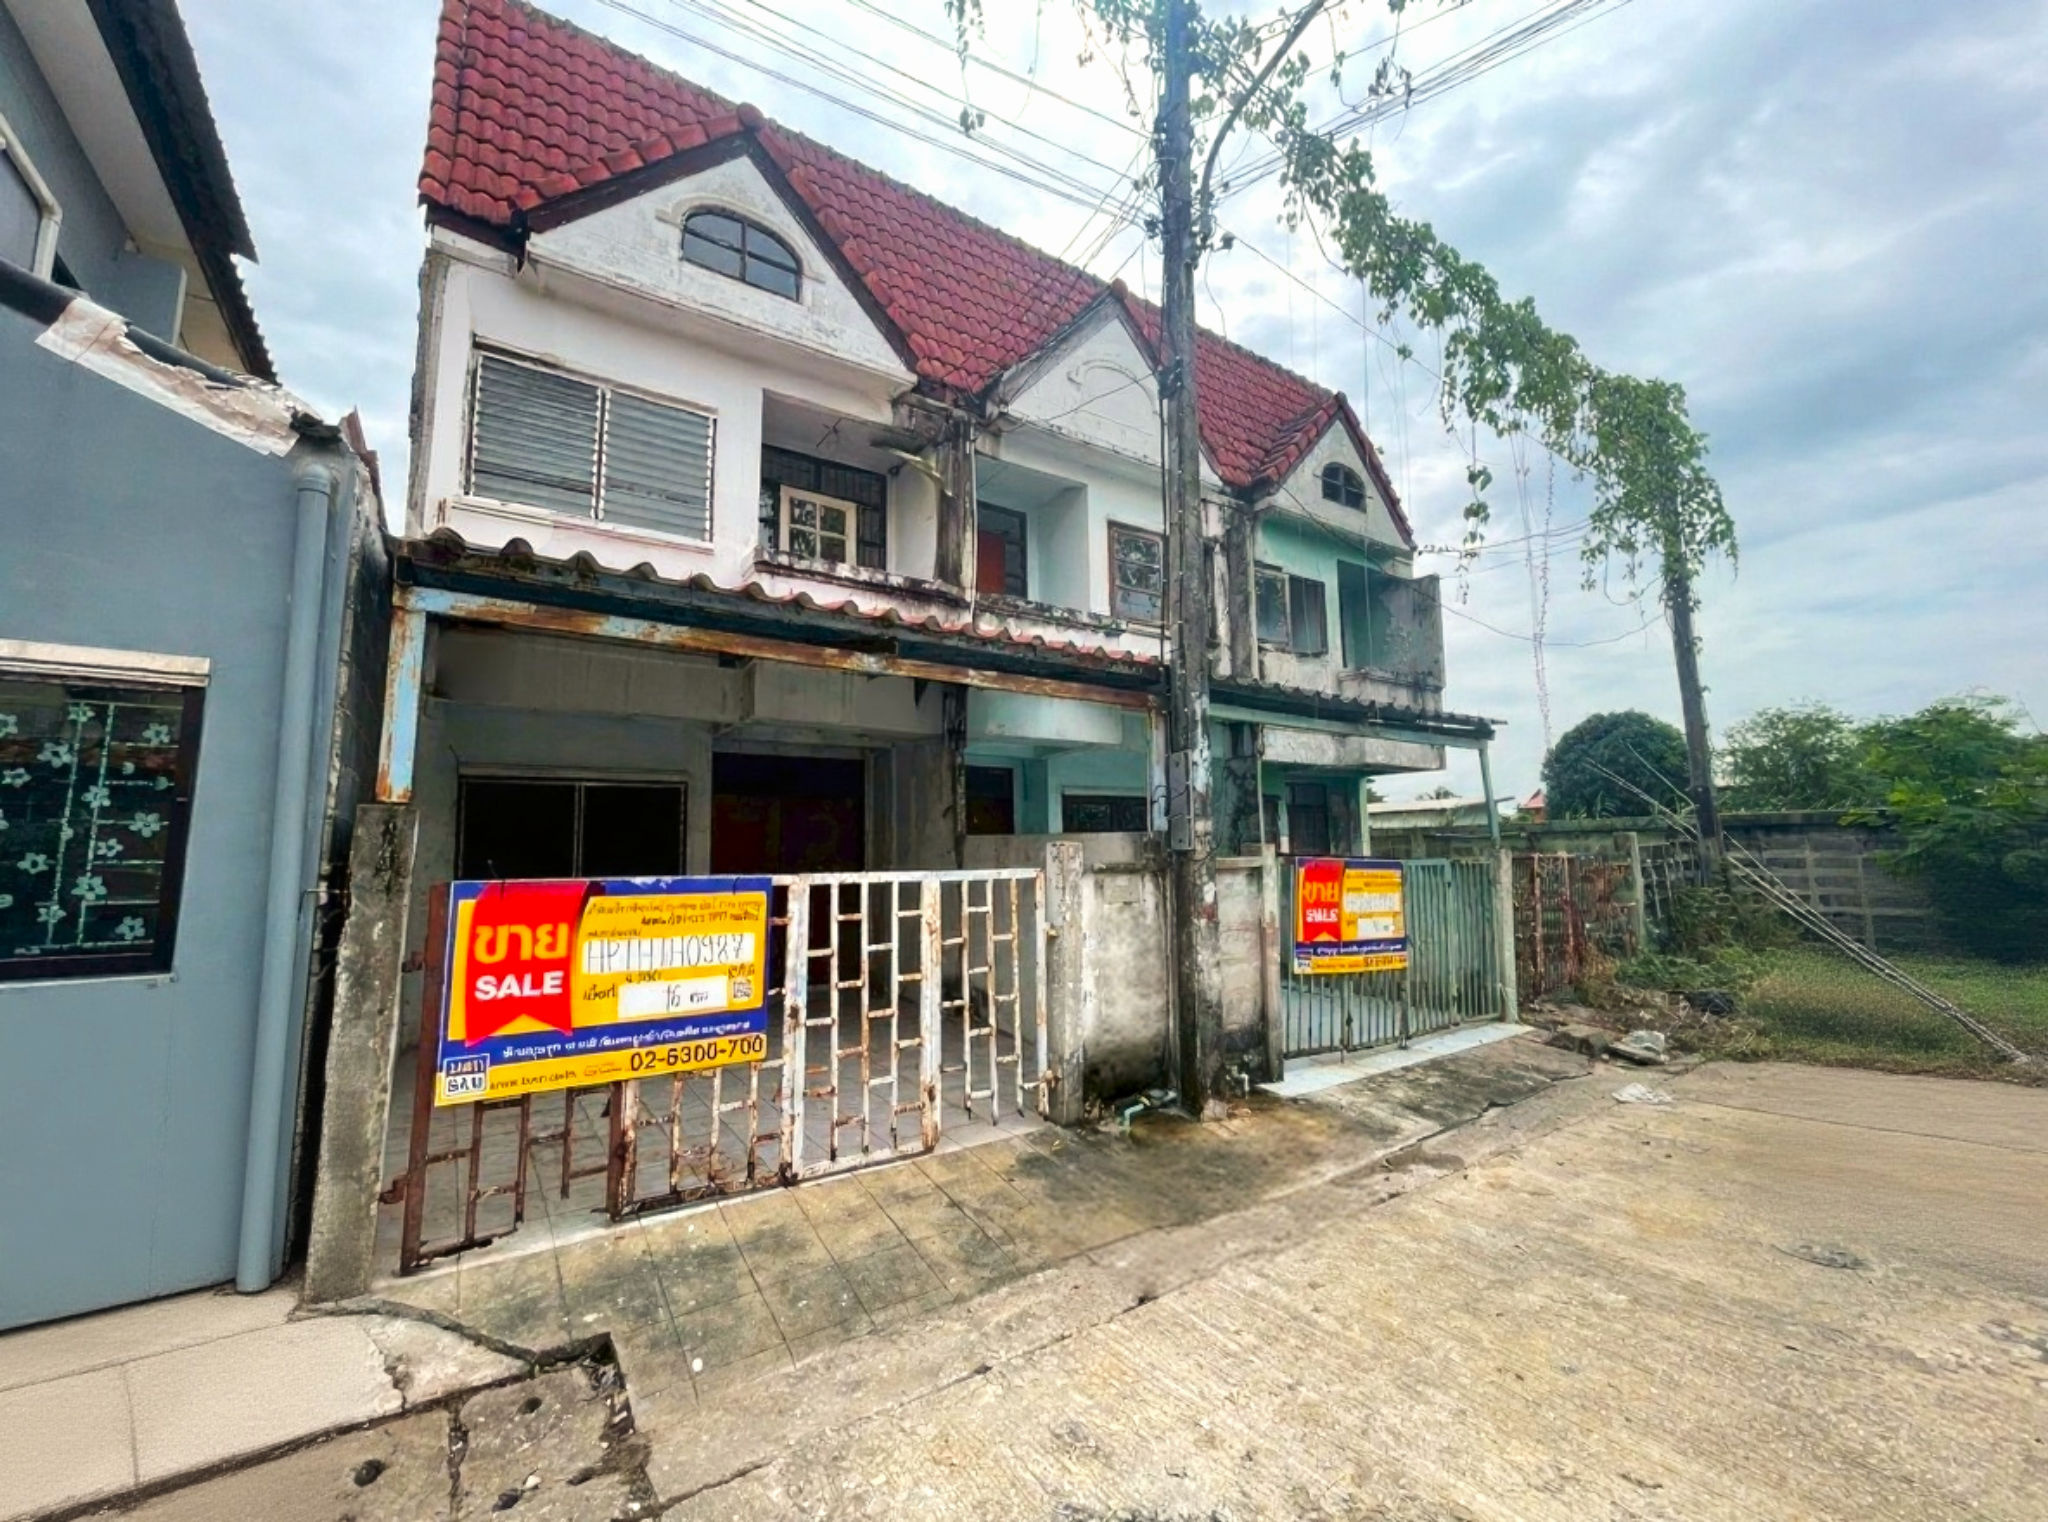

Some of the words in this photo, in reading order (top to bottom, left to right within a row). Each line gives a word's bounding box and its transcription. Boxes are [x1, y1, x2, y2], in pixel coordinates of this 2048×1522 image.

[1303, 881, 1340, 904] ขาย
[473, 921, 569, 964] ขาย
[474, 970, 565, 1002] SALE
[630, 1037, 765, 1071] 02-6300-700
